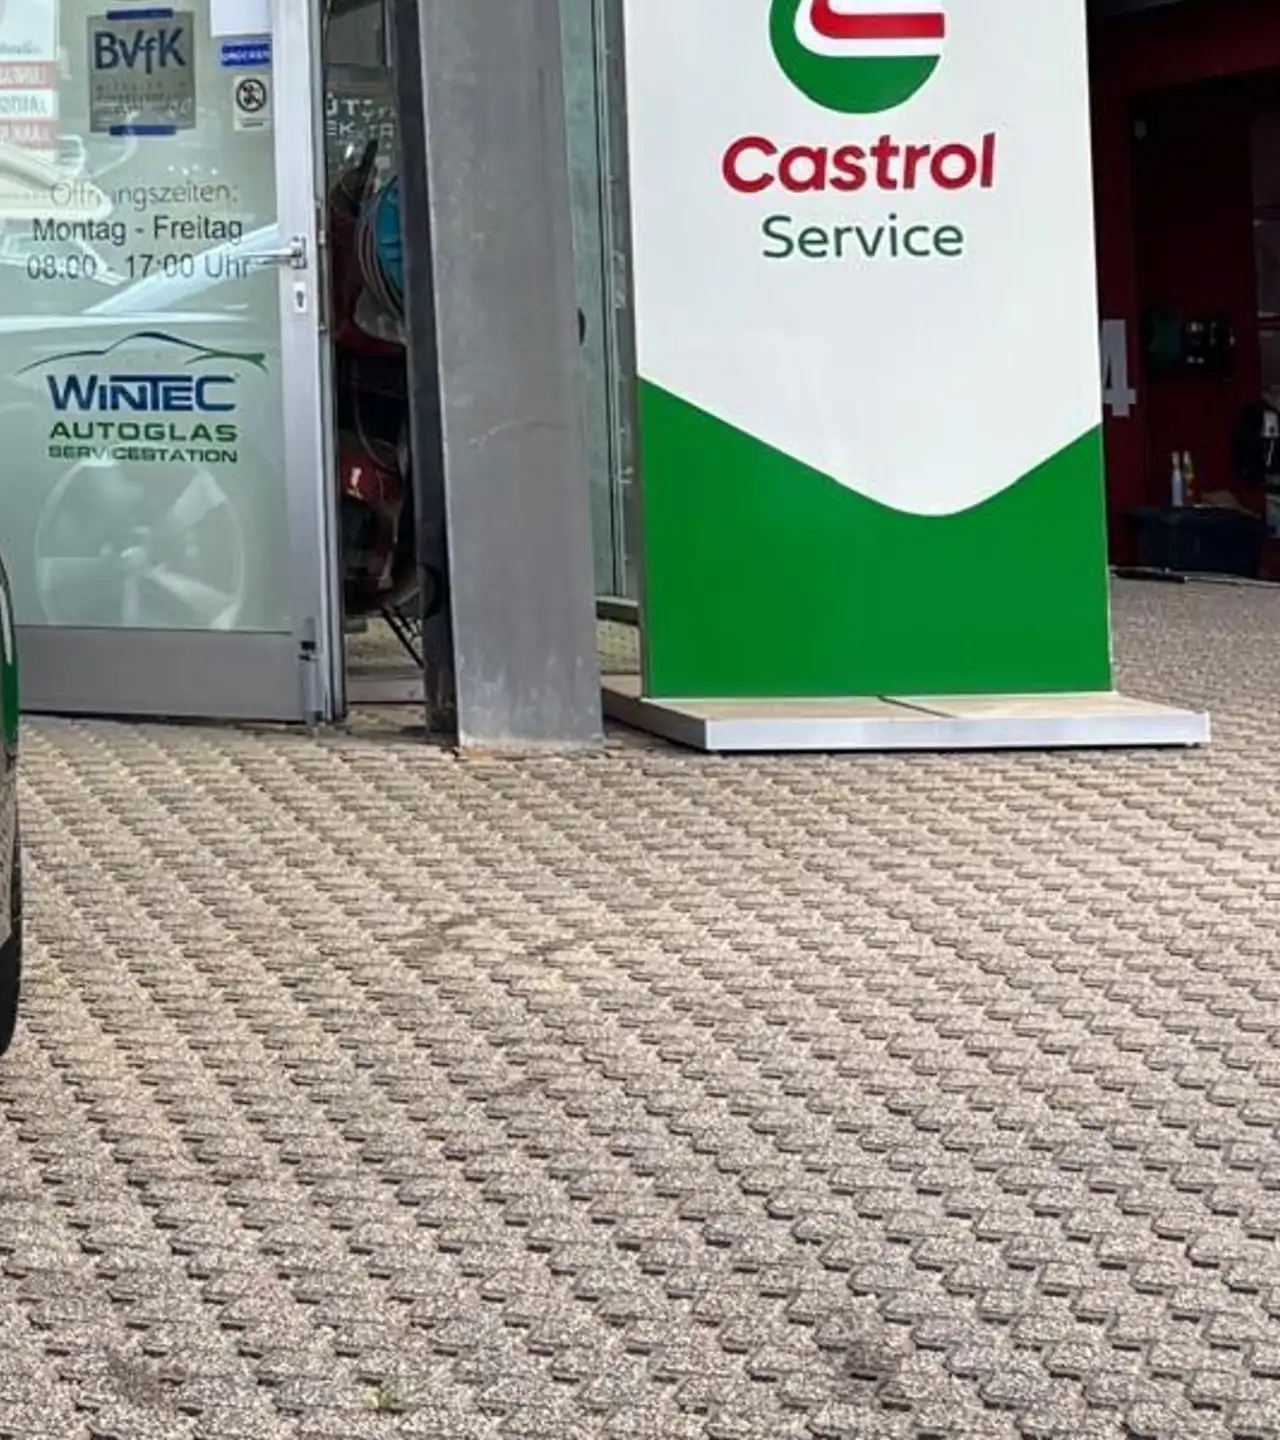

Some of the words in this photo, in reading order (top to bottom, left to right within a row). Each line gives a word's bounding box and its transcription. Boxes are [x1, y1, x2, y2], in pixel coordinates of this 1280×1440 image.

[722, 132, 996, 194] Castrol
[32, 217, 127, 246] Montag
[153, 214, 243, 245] Freitag
[761, 213, 964, 258] Service
[26, 254, 97, 279] 08:00
[125, 253, 194, 279] 17:00
[204, 253, 249, 279] Uhr
[1101, 319, 1137, 417] 4
[50, 420, 239, 443] AUTOGLAS
